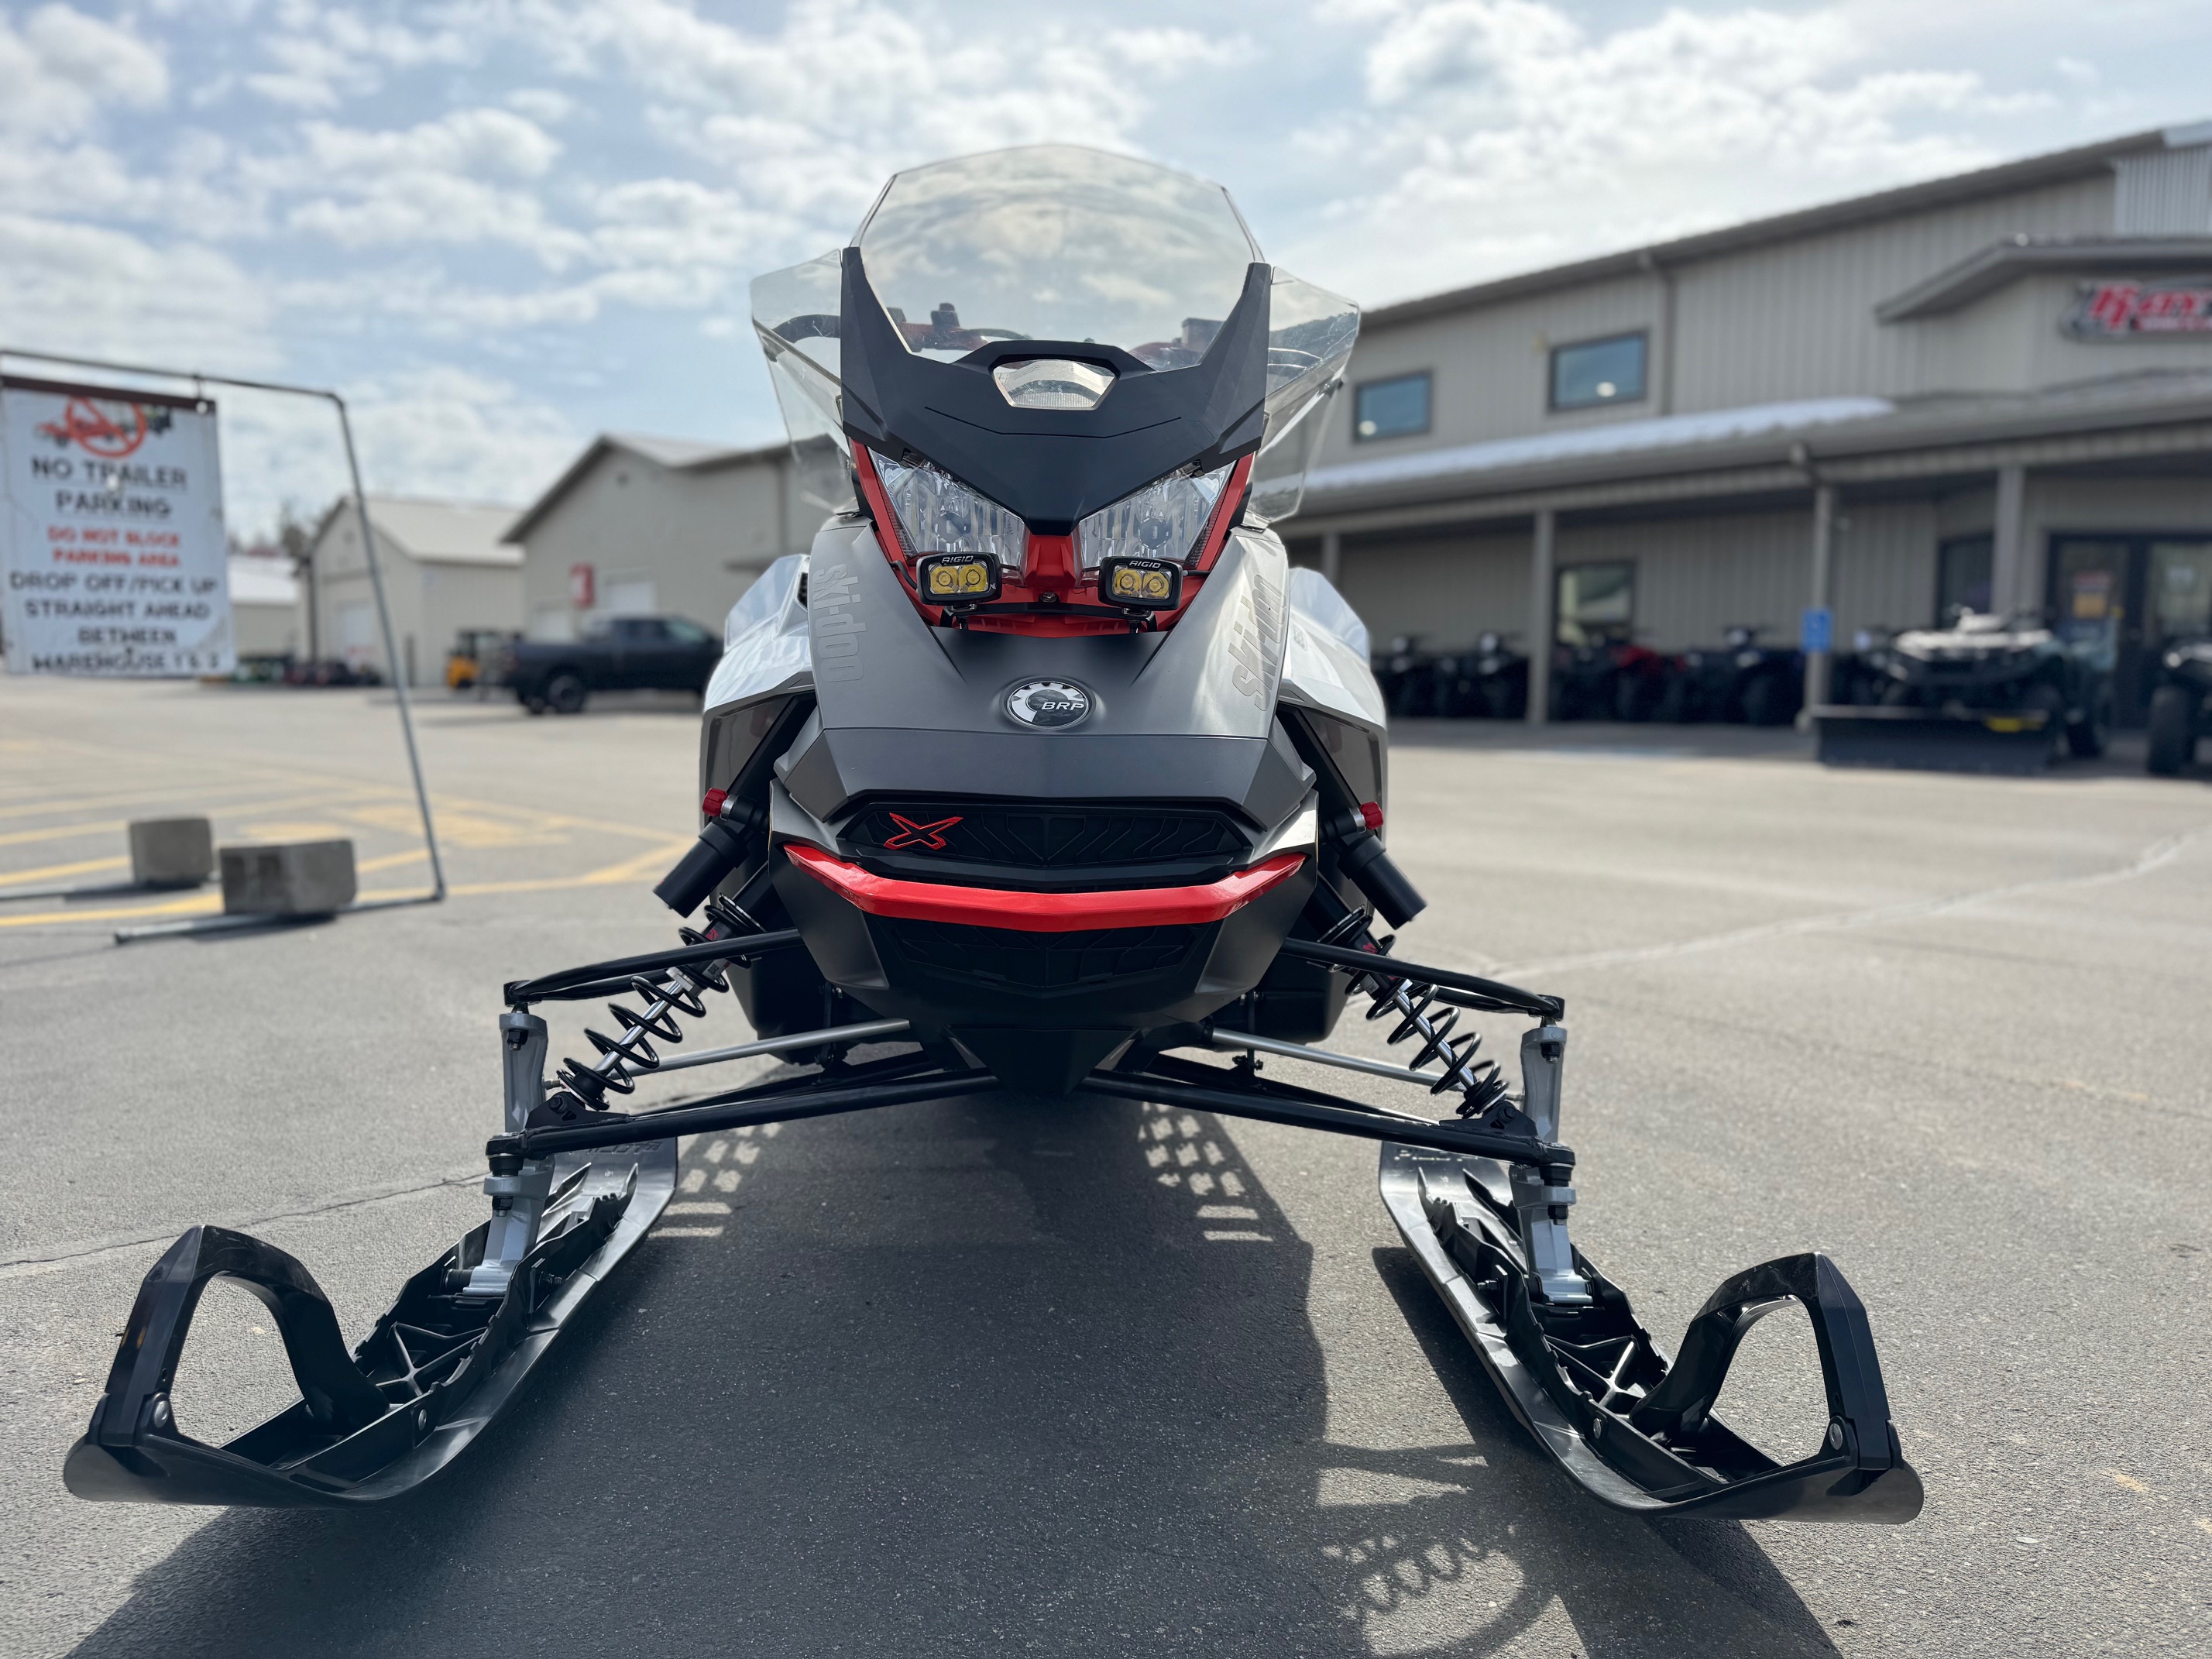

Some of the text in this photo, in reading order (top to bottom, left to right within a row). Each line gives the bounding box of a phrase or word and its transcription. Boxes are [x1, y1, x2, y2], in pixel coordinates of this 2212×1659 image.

[31, 457, 187, 488] NO TRAILER
[56, 490, 171, 517] PARKING
[47, 525, 180, 548] DO NOT BLOCK
[53, 548, 180, 567] PARKING AREA
[942, 555, 974, 564] RIGID
[1129, 560, 1161, 568] RIGID
[9, 572, 77, 590] DROP
[191, 577, 218, 594] UP
[25, 599, 210, 618] STRAIGHT AHEAD
[78, 627, 177, 644] BETWEEN
[32, 651, 167, 671] WAREHOUSE
[1041, 701, 1084, 711] BRP
